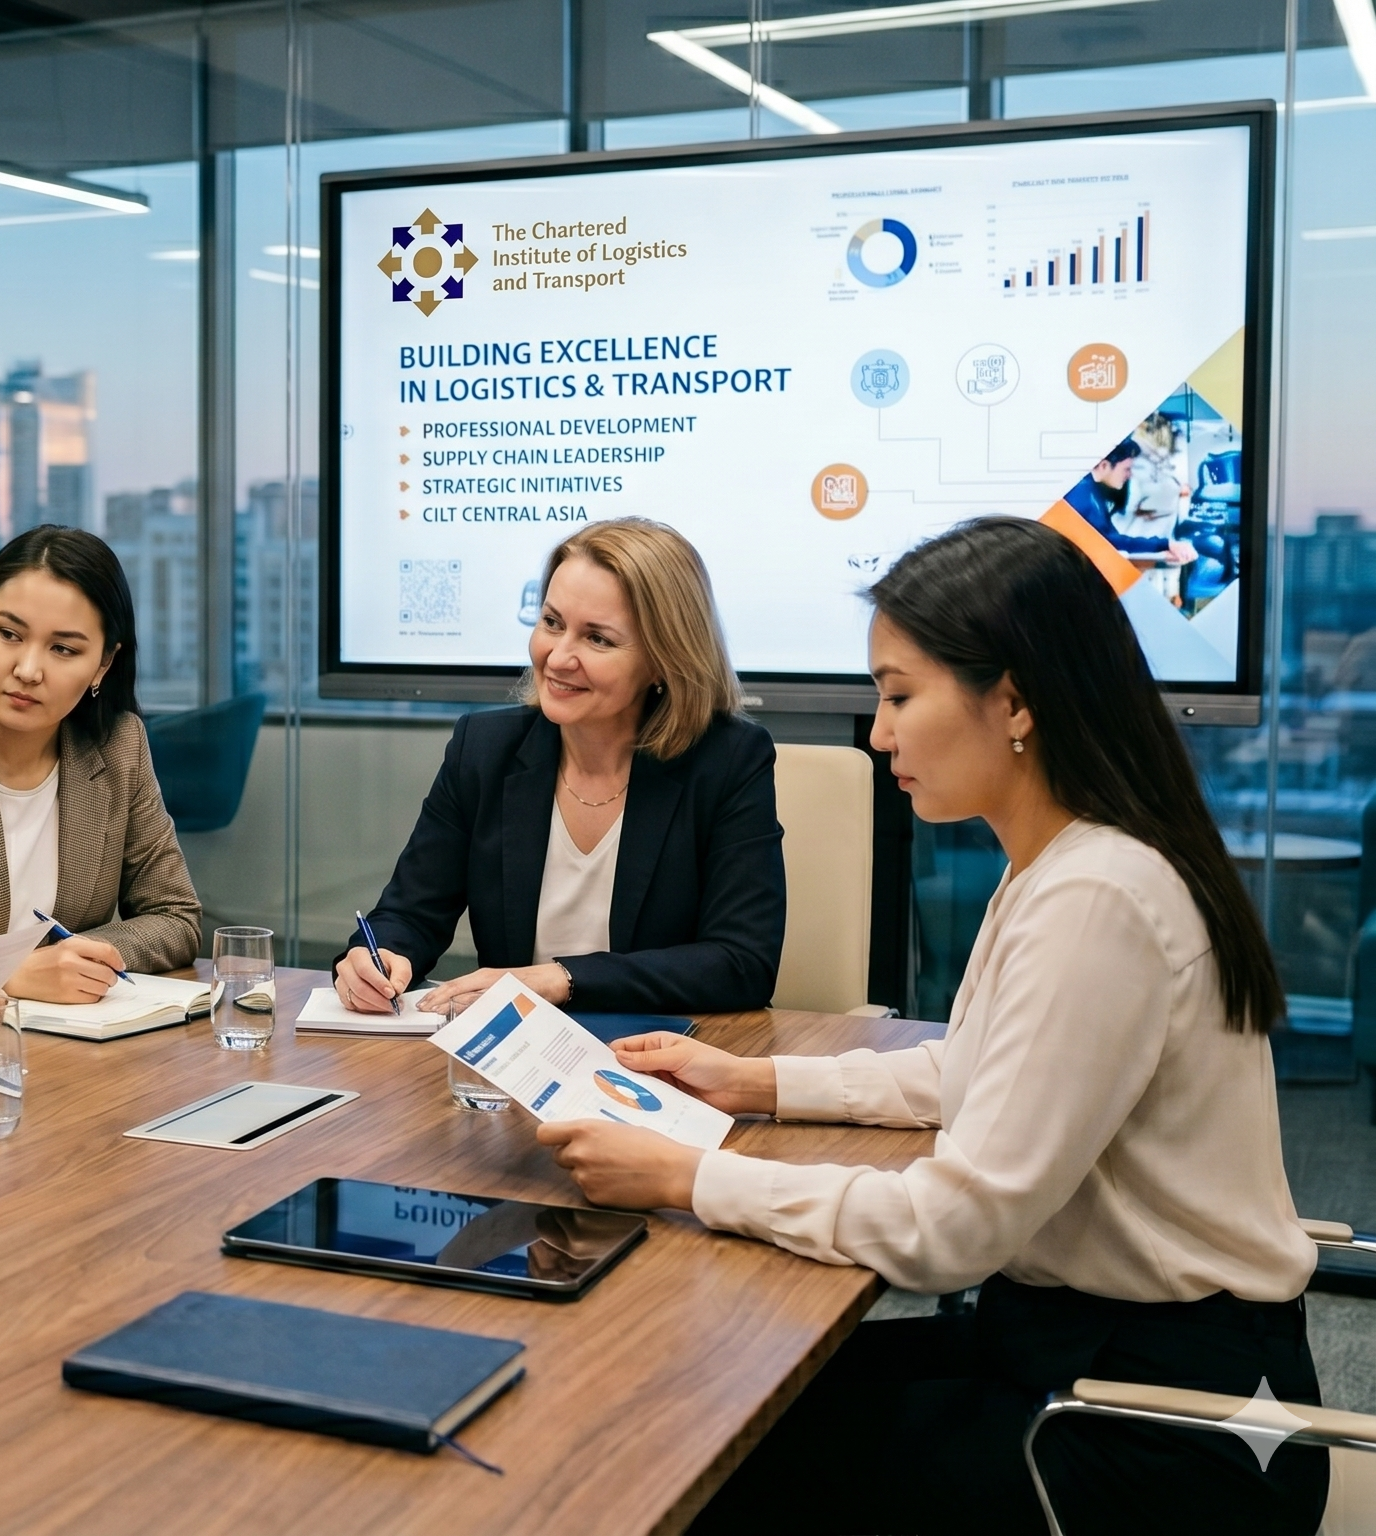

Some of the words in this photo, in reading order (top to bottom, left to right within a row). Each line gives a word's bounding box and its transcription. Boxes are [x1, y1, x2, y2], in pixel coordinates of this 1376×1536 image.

[491, 222, 527, 242] The
[531, 216, 627, 240] Chartered
[493, 246, 571, 267] Institute
[576, 242, 598, 263] of
[602, 239, 688, 266] Logistics
[492, 271, 527, 292] and
[532, 268, 626, 293] Transport
[400, 341, 531, 370] BUILDING
[540, 334, 718, 364] EXCELLENCE
[400, 379, 426, 404] IN
[435, 374, 577, 402] LOGISTICS
[584, 373, 605, 398] &
[612, 367, 792, 397] TRANSPORT
[423, 420, 555, 439] PROFESSIONAL
[560, 416, 697, 436] DEVELOPMENT
[422, 450, 488, 467] SUPPLY
[492, 449, 548, 466] CHAIN
[553, 446, 665, 464] LEADERSHIP
[422, 477, 516, 495] STRATEGIC
[521, 476, 623, 493] INITIATIVES
[422, 507, 458, 523] CILT
[462, 506, 542, 522] CENTRAL
[545, 505, 588, 522] ASIA
